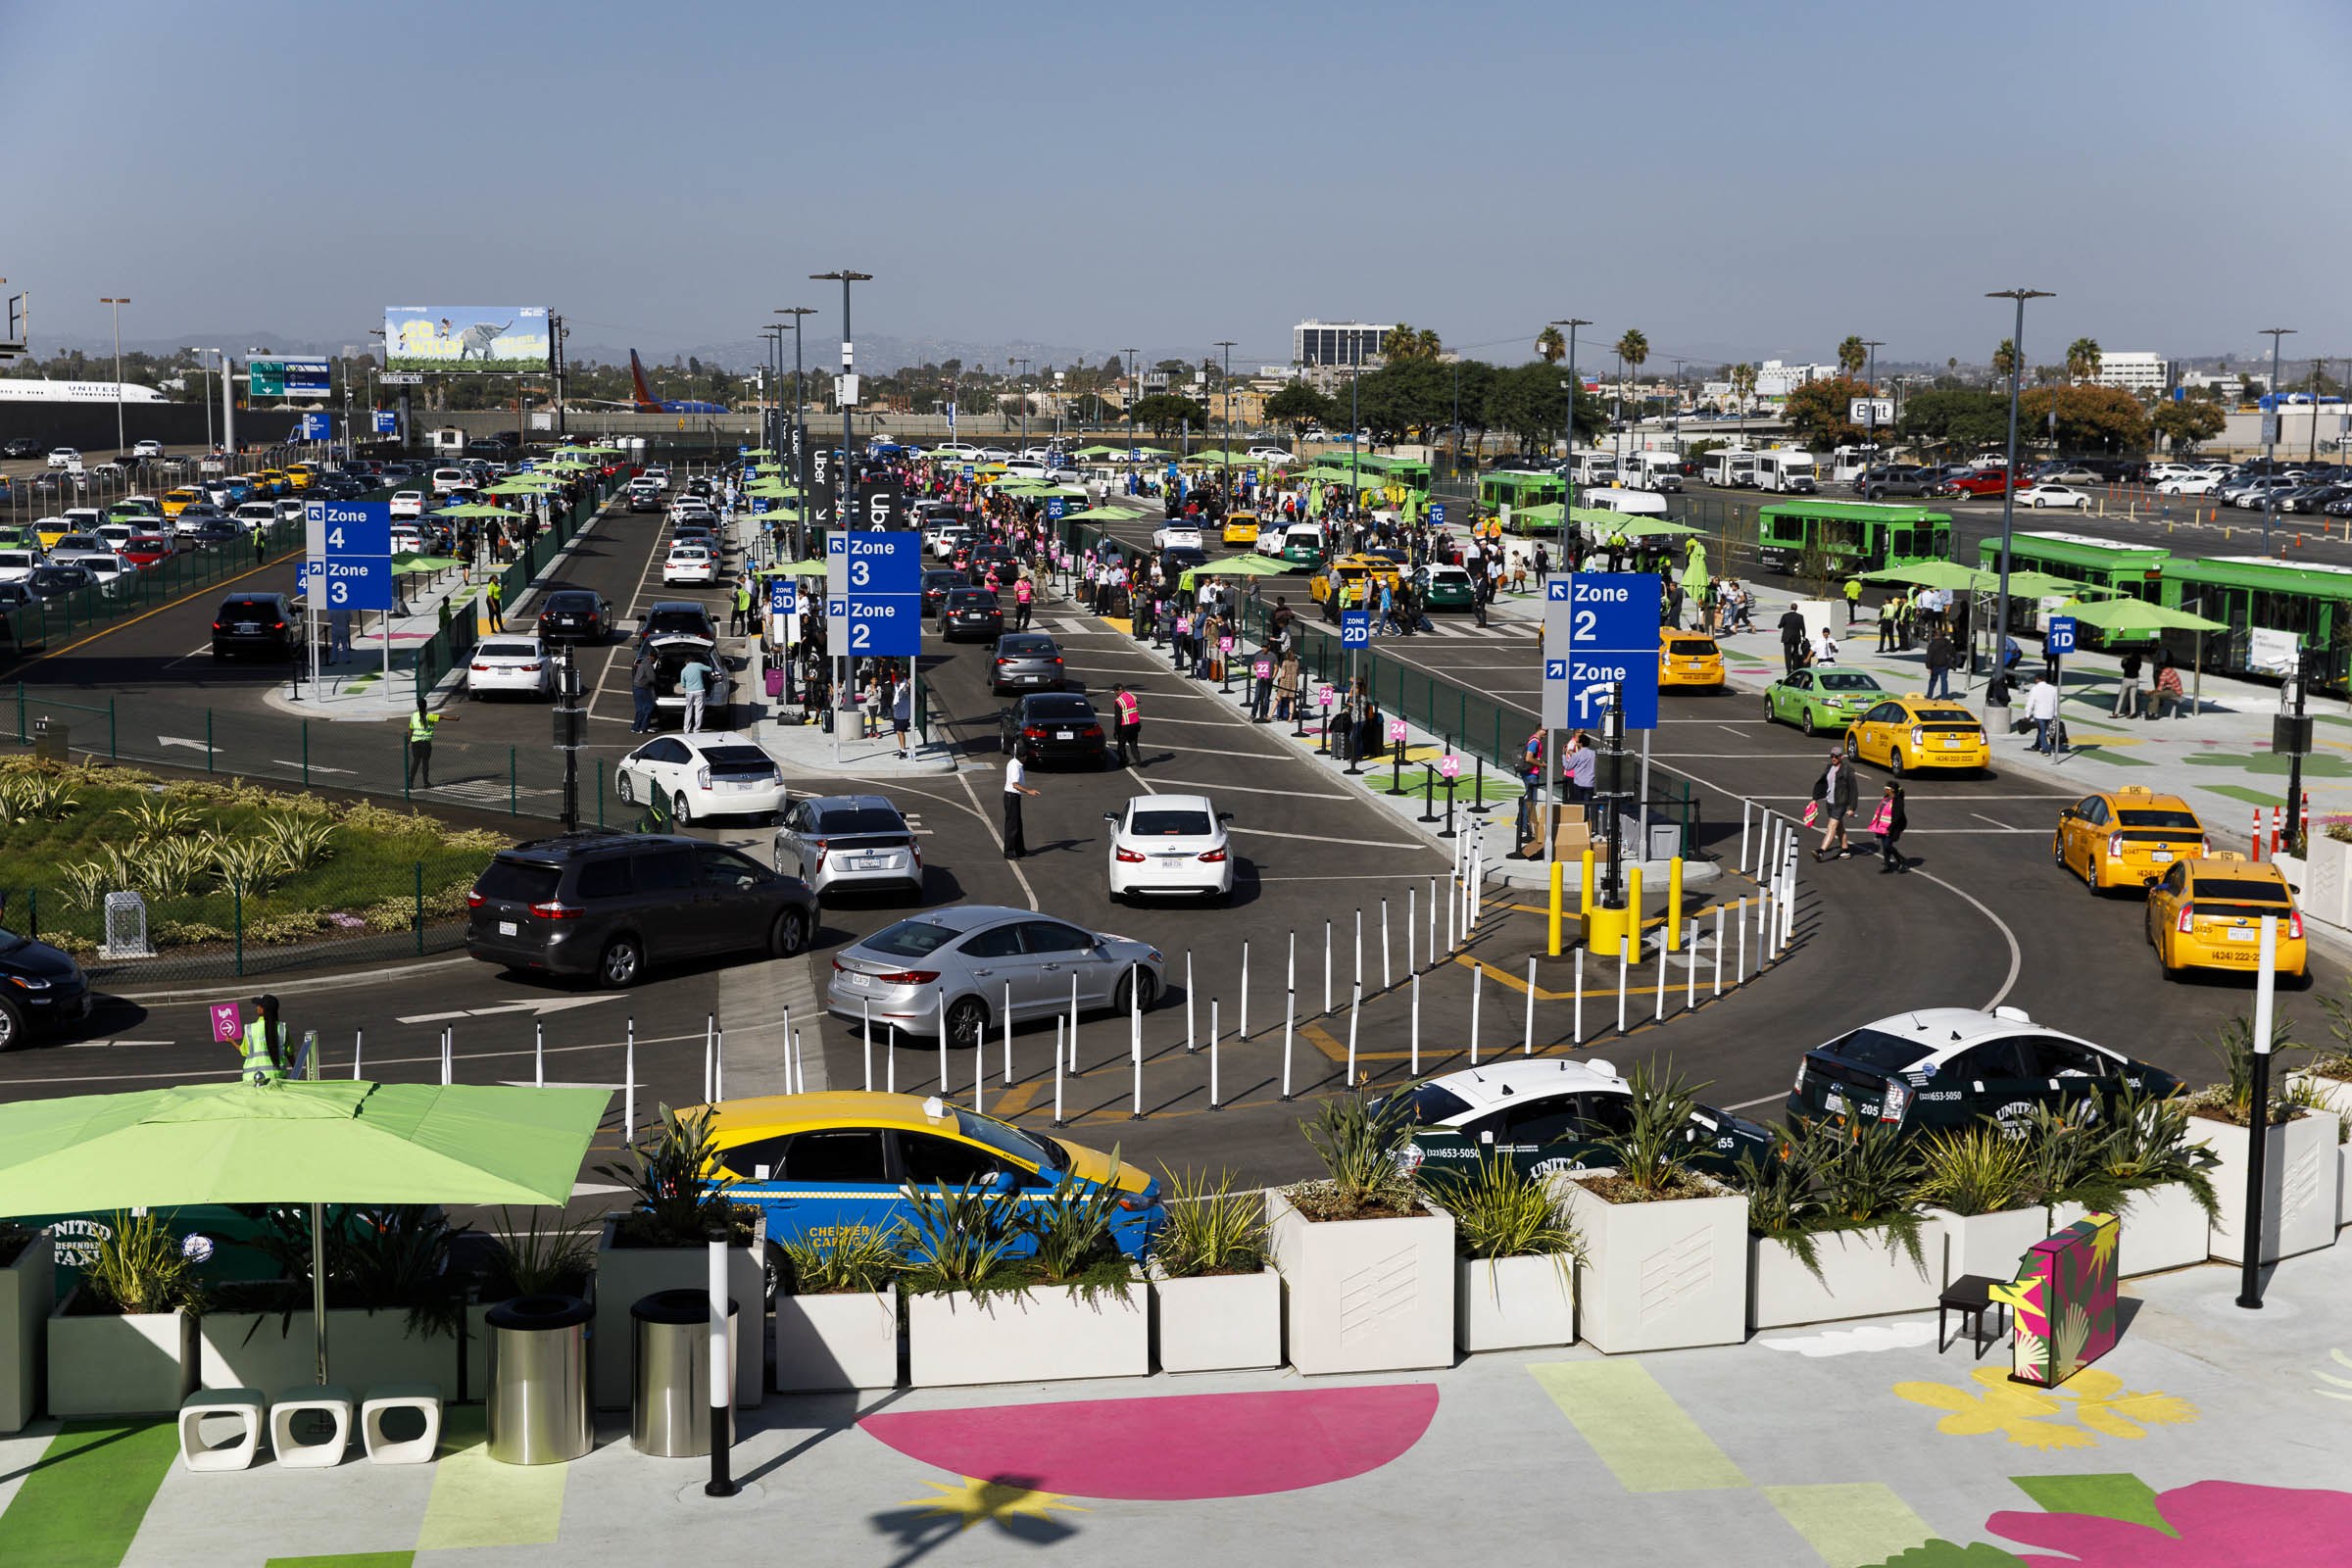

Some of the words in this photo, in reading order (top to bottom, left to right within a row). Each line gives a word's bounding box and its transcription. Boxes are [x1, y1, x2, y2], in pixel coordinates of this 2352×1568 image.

[403, 321, 435, 338] GO
[1857, 404, 1888, 417] Eit
[813, 450, 828, 485] Uber
[327, 510, 368, 522] Zone
[1049, 507, 1062, 515] 2C
[1431, 513, 1444, 521] 1C
[328, 527, 345, 549] 4
[851, 540, 895, 555] Zone
[329, 564, 368, 576] Zone
[852, 561, 870, 586] 3
[331, 581, 349, 604] 3
[1575, 583, 1629, 602] Zone
[773, 595, 795, 610] 3D
[851, 603, 896, 617] Zone
[1574, 610, 1597, 641] 2
[852, 623, 870, 649] 2
[1344, 627, 1368, 642] 2D
[2052, 633, 2074, 647] 1D
[1256, 663, 1269, 672] 22
[1572, 662, 1627, 681] Zone
[1320, 690, 1333, 700] 23
[1574, 689, 1590, 719] 1
[1391, 723, 1405, 734] 24
[1443, 760, 1458, 770] 24
[2136, 868, 2155, 878] (424)
[2194, 925, 2213, 934] 6125
[2212, 952, 2233, 961] (424)
[2234, 952, 2260, 961] 222-22
[1860, 1102, 1880, 1117] 205
[1426, 1148, 1481, 1158] (323)653-5050
[48, 1219, 112, 1242] NITED
